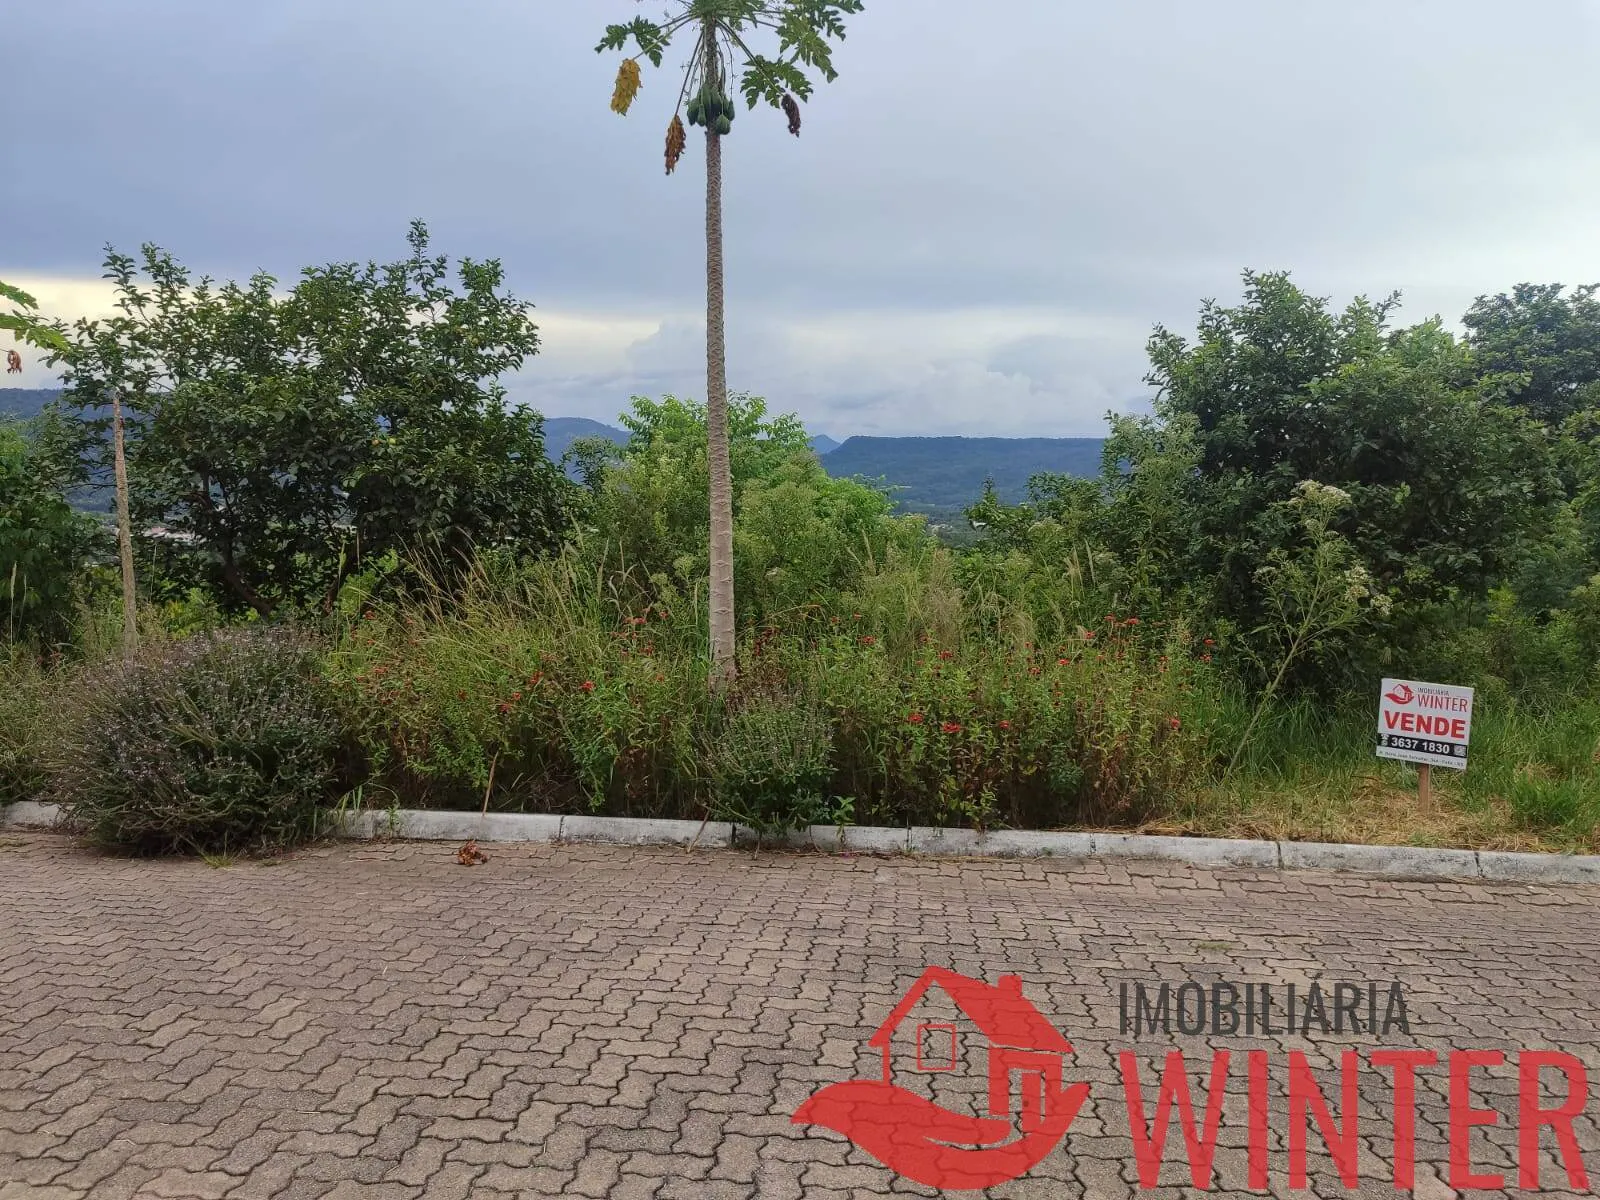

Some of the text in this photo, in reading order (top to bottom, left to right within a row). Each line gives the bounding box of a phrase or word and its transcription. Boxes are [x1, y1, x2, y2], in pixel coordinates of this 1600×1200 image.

[1417, 694, 1468, 712] WINTER
[1384, 710, 1466, 739] VENDE
[1391, 737, 1450, 754] 3637 1830
